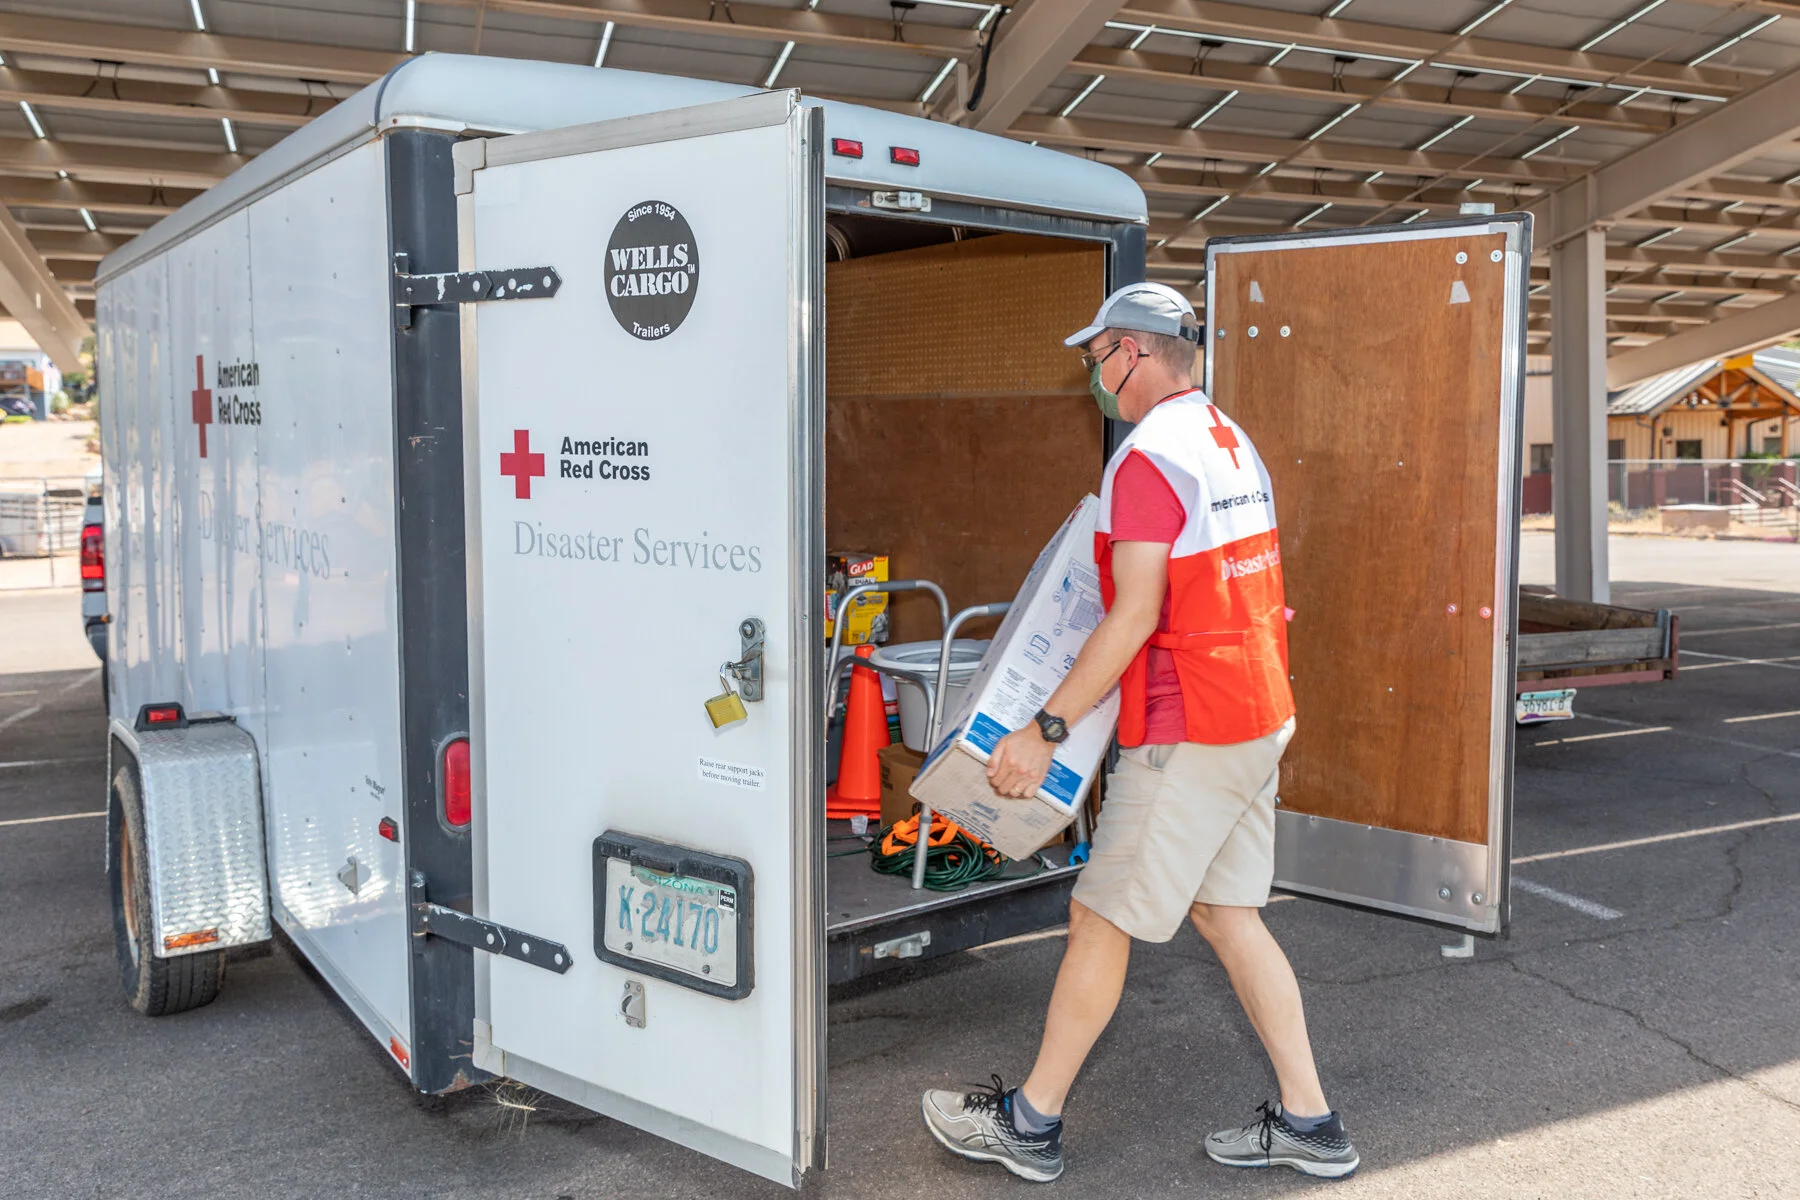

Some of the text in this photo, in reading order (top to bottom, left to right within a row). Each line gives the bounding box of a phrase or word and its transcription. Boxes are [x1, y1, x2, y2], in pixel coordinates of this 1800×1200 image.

[628, 203, 676, 222] Since 1954
[610, 243, 689, 271] WELLS
[610, 271, 689, 297] CARGO
[632, 321, 671, 337] Trailers
[217, 357, 260, 388] American
[218, 394, 262, 426] Red Cross
[560, 436, 649, 456] American
[560, 459, 651, 481] Red Cross
[1211, 494, 1250, 512] merican
[255, 501, 331, 580] Services
[513, 520, 763, 574] Disaster Services
[850, 561, 874, 576] GLAD
[699, 757, 764, 777] Raise rear support jacks
[702, 769, 761, 788] before moving trailer.
[650, 875, 705, 896] RIZONA
